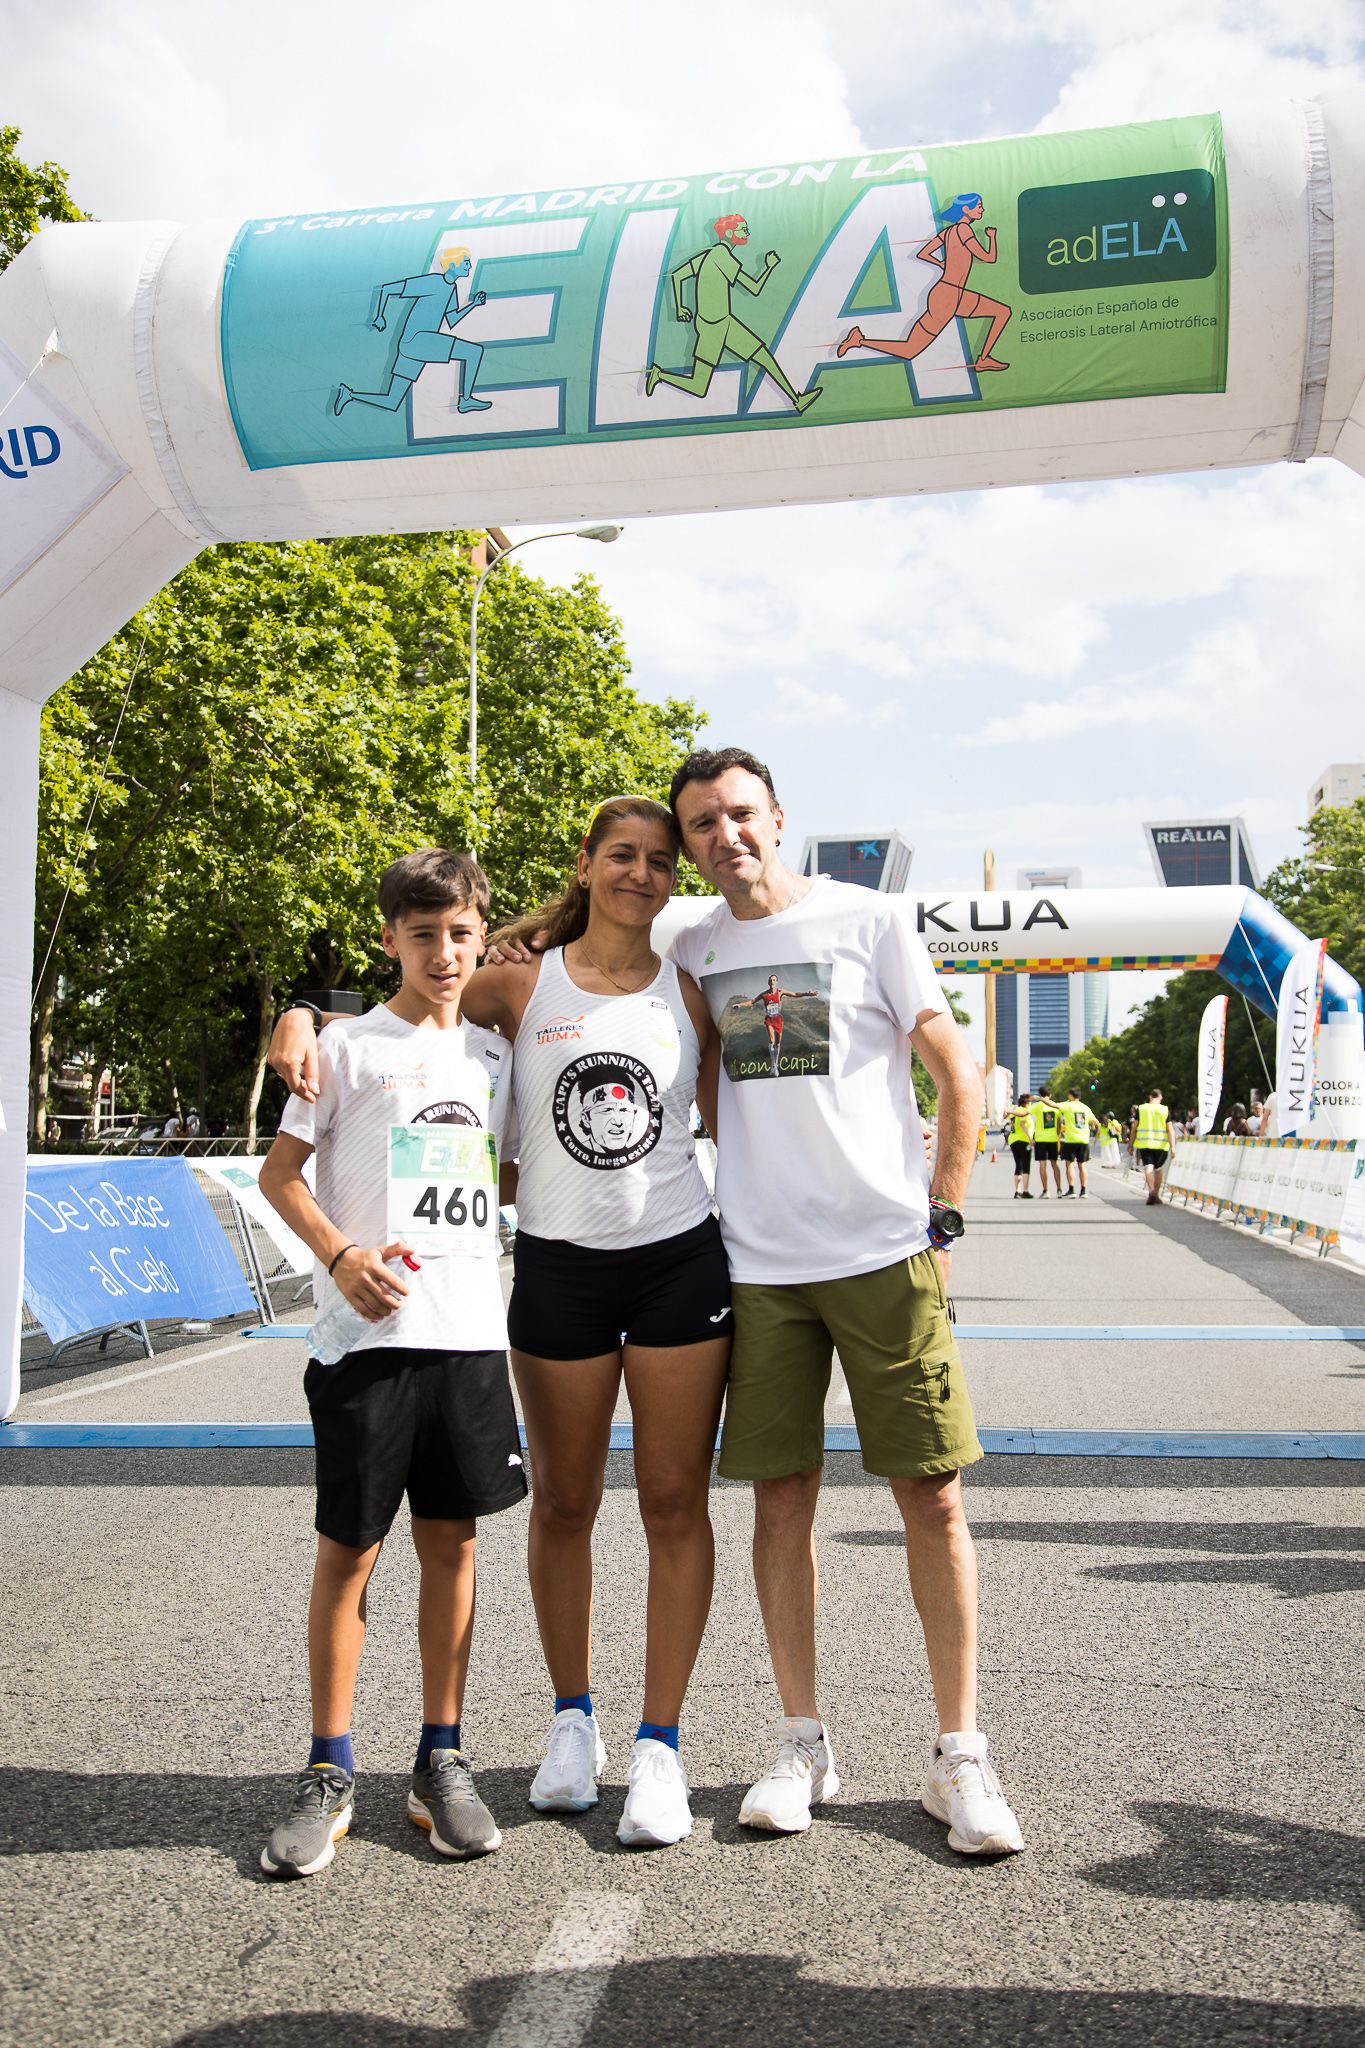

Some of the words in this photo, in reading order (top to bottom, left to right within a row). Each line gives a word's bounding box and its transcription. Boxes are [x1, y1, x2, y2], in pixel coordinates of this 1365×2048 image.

[302, 208, 437, 231] Carrera
[448, 178, 689, 221] MADRID
[705, 162, 834, 194] CON
[850, 151, 929, 178] LA
[1046, 217, 1189, 266] adELA
[408, 178, 982, 446] ELA
[1019, 304, 1093, 322] Asociación
[1097, 296, 1158, 316] Española
[1161, 295, 1180, 309] de
[1020, 327, 1087, 343] Esclerosis
[1090, 320, 1136, 337] Lateral
[1139, 314, 1217, 332] Amiotrófica
[1156, 828, 1228, 844] REALIA
[917, 898, 1070, 933] KUA
[927, 941, 999, 953] COLOURS
[536, 1025, 585, 1040] TALLERES
[537, 1031, 582, 1045] JUMA
[1288, 986, 1310, 1112] MUKUA
[575, 1054, 646, 1077] RUNNING
[740, 1061, 771, 1075] con
[592, 1155, 628, 1168] luego
[627, 1132, 657, 1161] existe
[24, 1190, 91, 1234] De
[68, 1183, 121, 1229] la
[99, 1181, 171, 1230] Base
[412, 1186, 489, 1228] 460
[88, 1249, 129, 1297] al
[109, 1245, 181, 1295] Cielo
